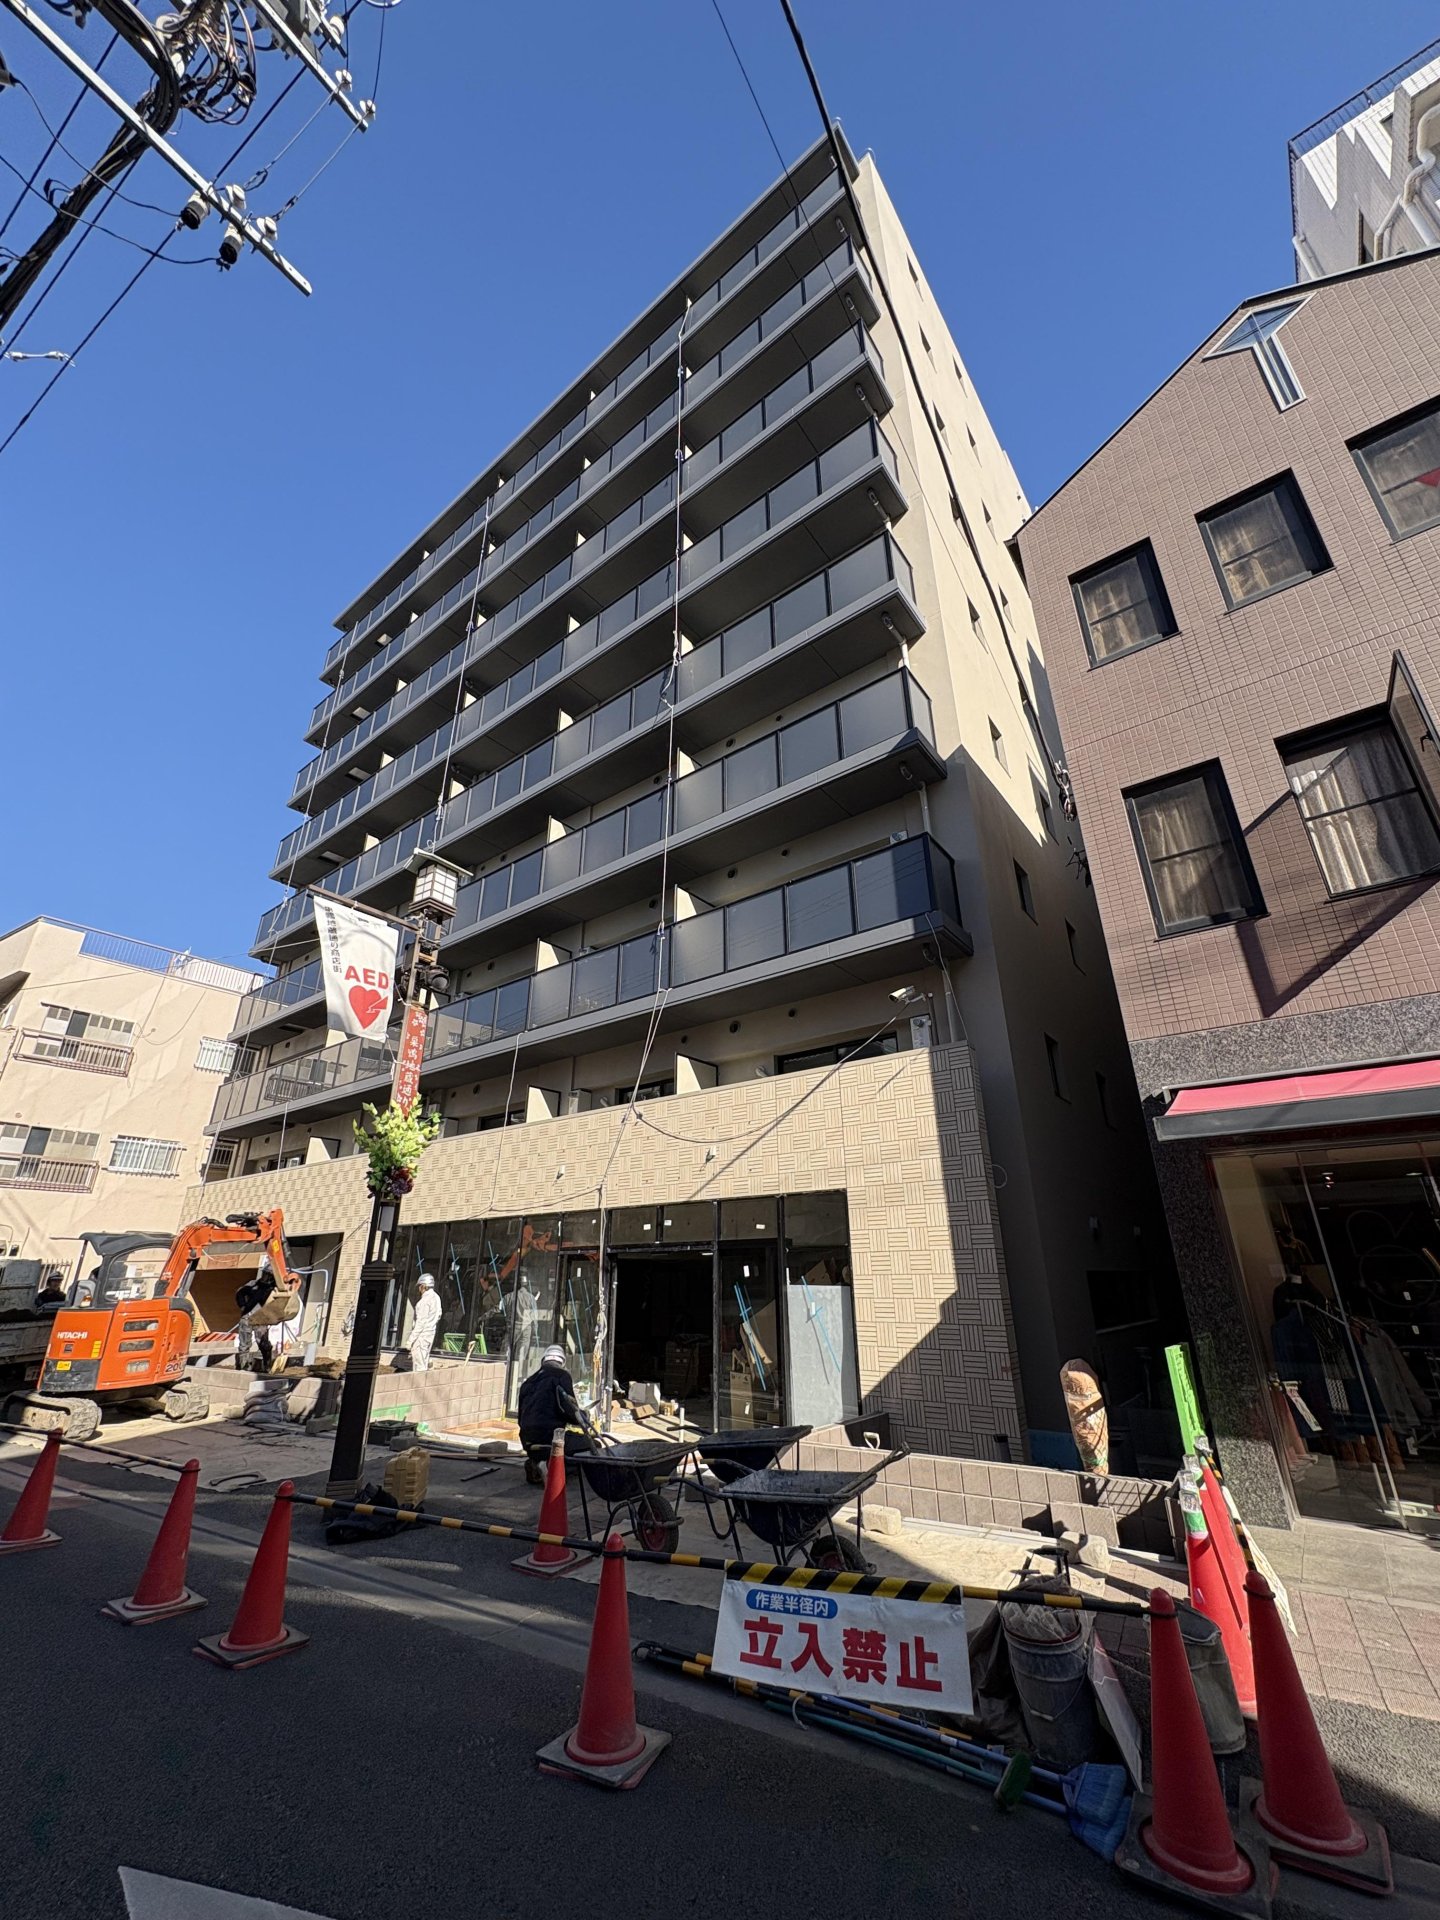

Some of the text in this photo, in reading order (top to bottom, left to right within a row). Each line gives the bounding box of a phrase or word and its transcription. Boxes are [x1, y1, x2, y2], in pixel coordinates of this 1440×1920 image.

[344, 965, 389, 989] AED
[401, 1036, 420, 1107] 巣鴨地蔵通り
[57, 1331, 88, 1339] HITACHI
[755, 1591, 829, 1617] 作業半径内
[739, 1616, 943, 1692] 立入禁止
